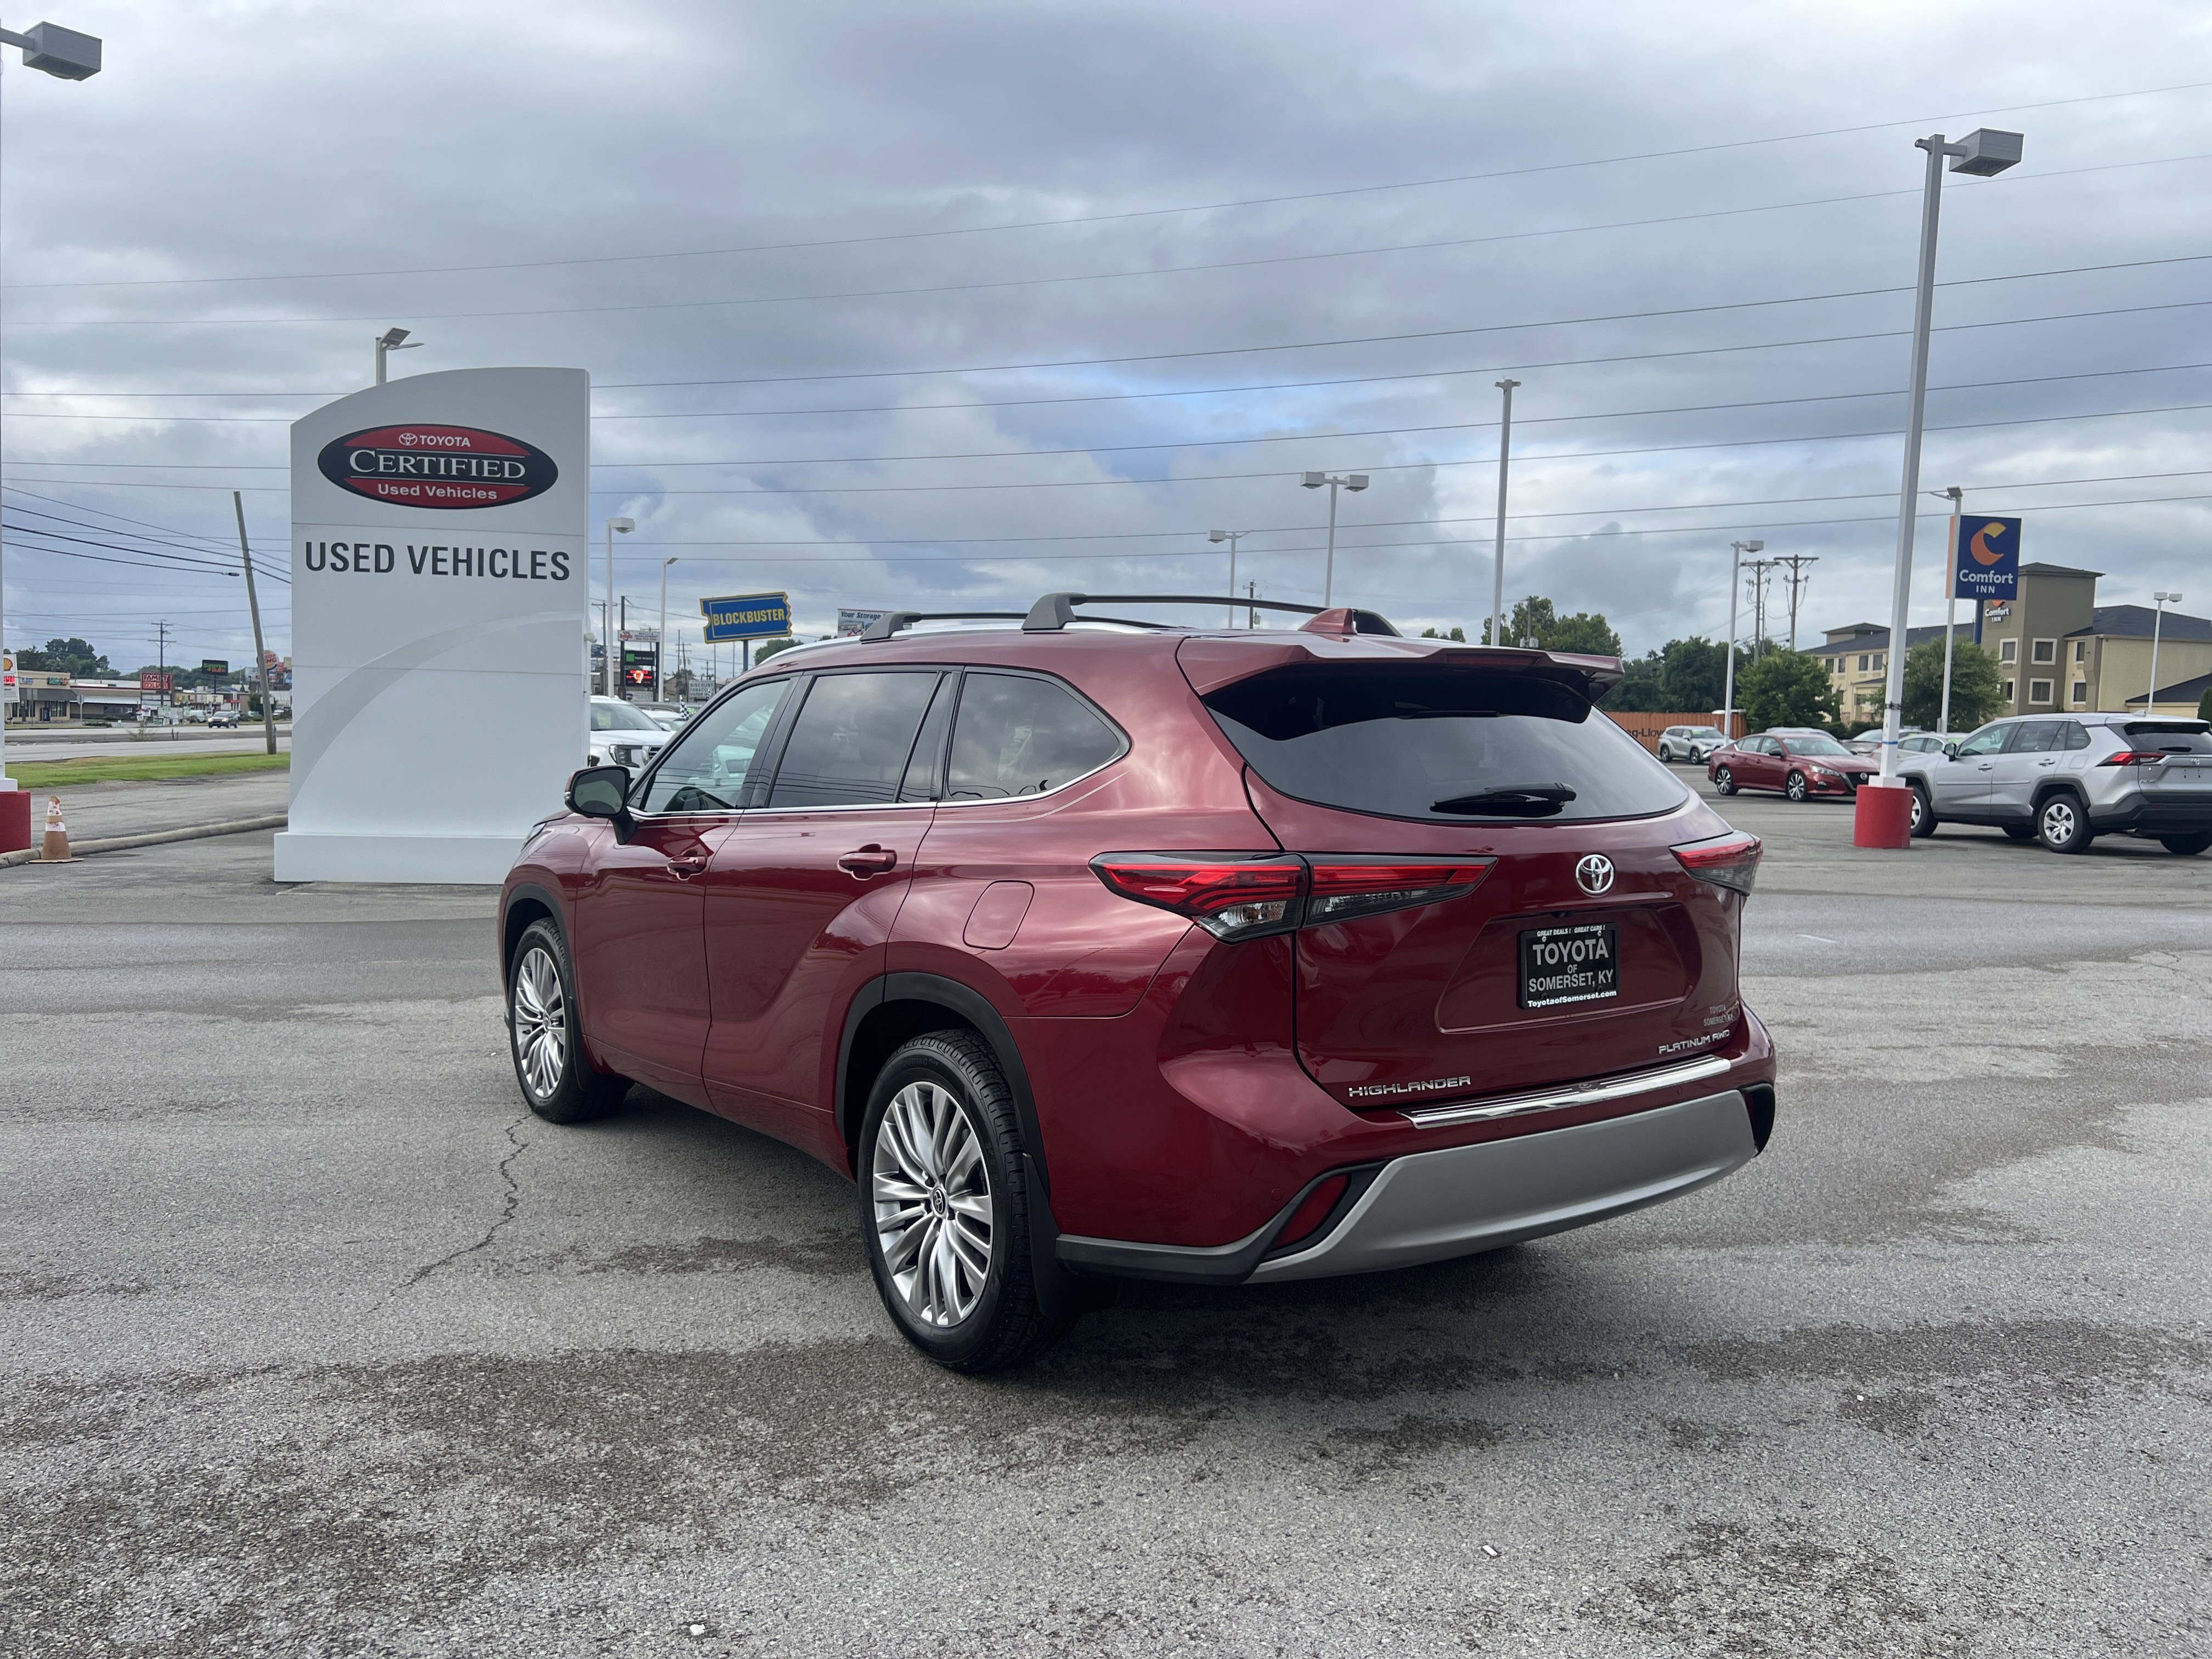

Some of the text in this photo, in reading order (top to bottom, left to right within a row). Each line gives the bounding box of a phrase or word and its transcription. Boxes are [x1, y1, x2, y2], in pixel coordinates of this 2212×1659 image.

[420, 435, 471, 447] TOYOTA
[349, 449, 526, 479] CERTIFIED
[377, 483, 498, 499] Used Vehicles
[306, 541, 570, 581] USED VEHICLES
[1959, 569, 2013, 584] Comfort
[1976, 585, 1995, 594] INN
[713, 608, 785, 626] BLOCKBUSTER
[856, 612, 881, 620] Storage
[1984, 607, 2010, 617] Comfort
[1532, 938, 1609, 966] TOYOTA
[1567, 964, 1578, 974] OF
[1528, 969, 1613, 992] SOMERSET, KY
[1527, 990, 1617, 1008] ToyotaofSomerset.com
[1709, 1004, 1726, 1014] TOYOTA
[1658, 1029, 1730, 1054] PLATINUM AWD
[1348, 1075, 1471, 1097] HIGHLANDER
